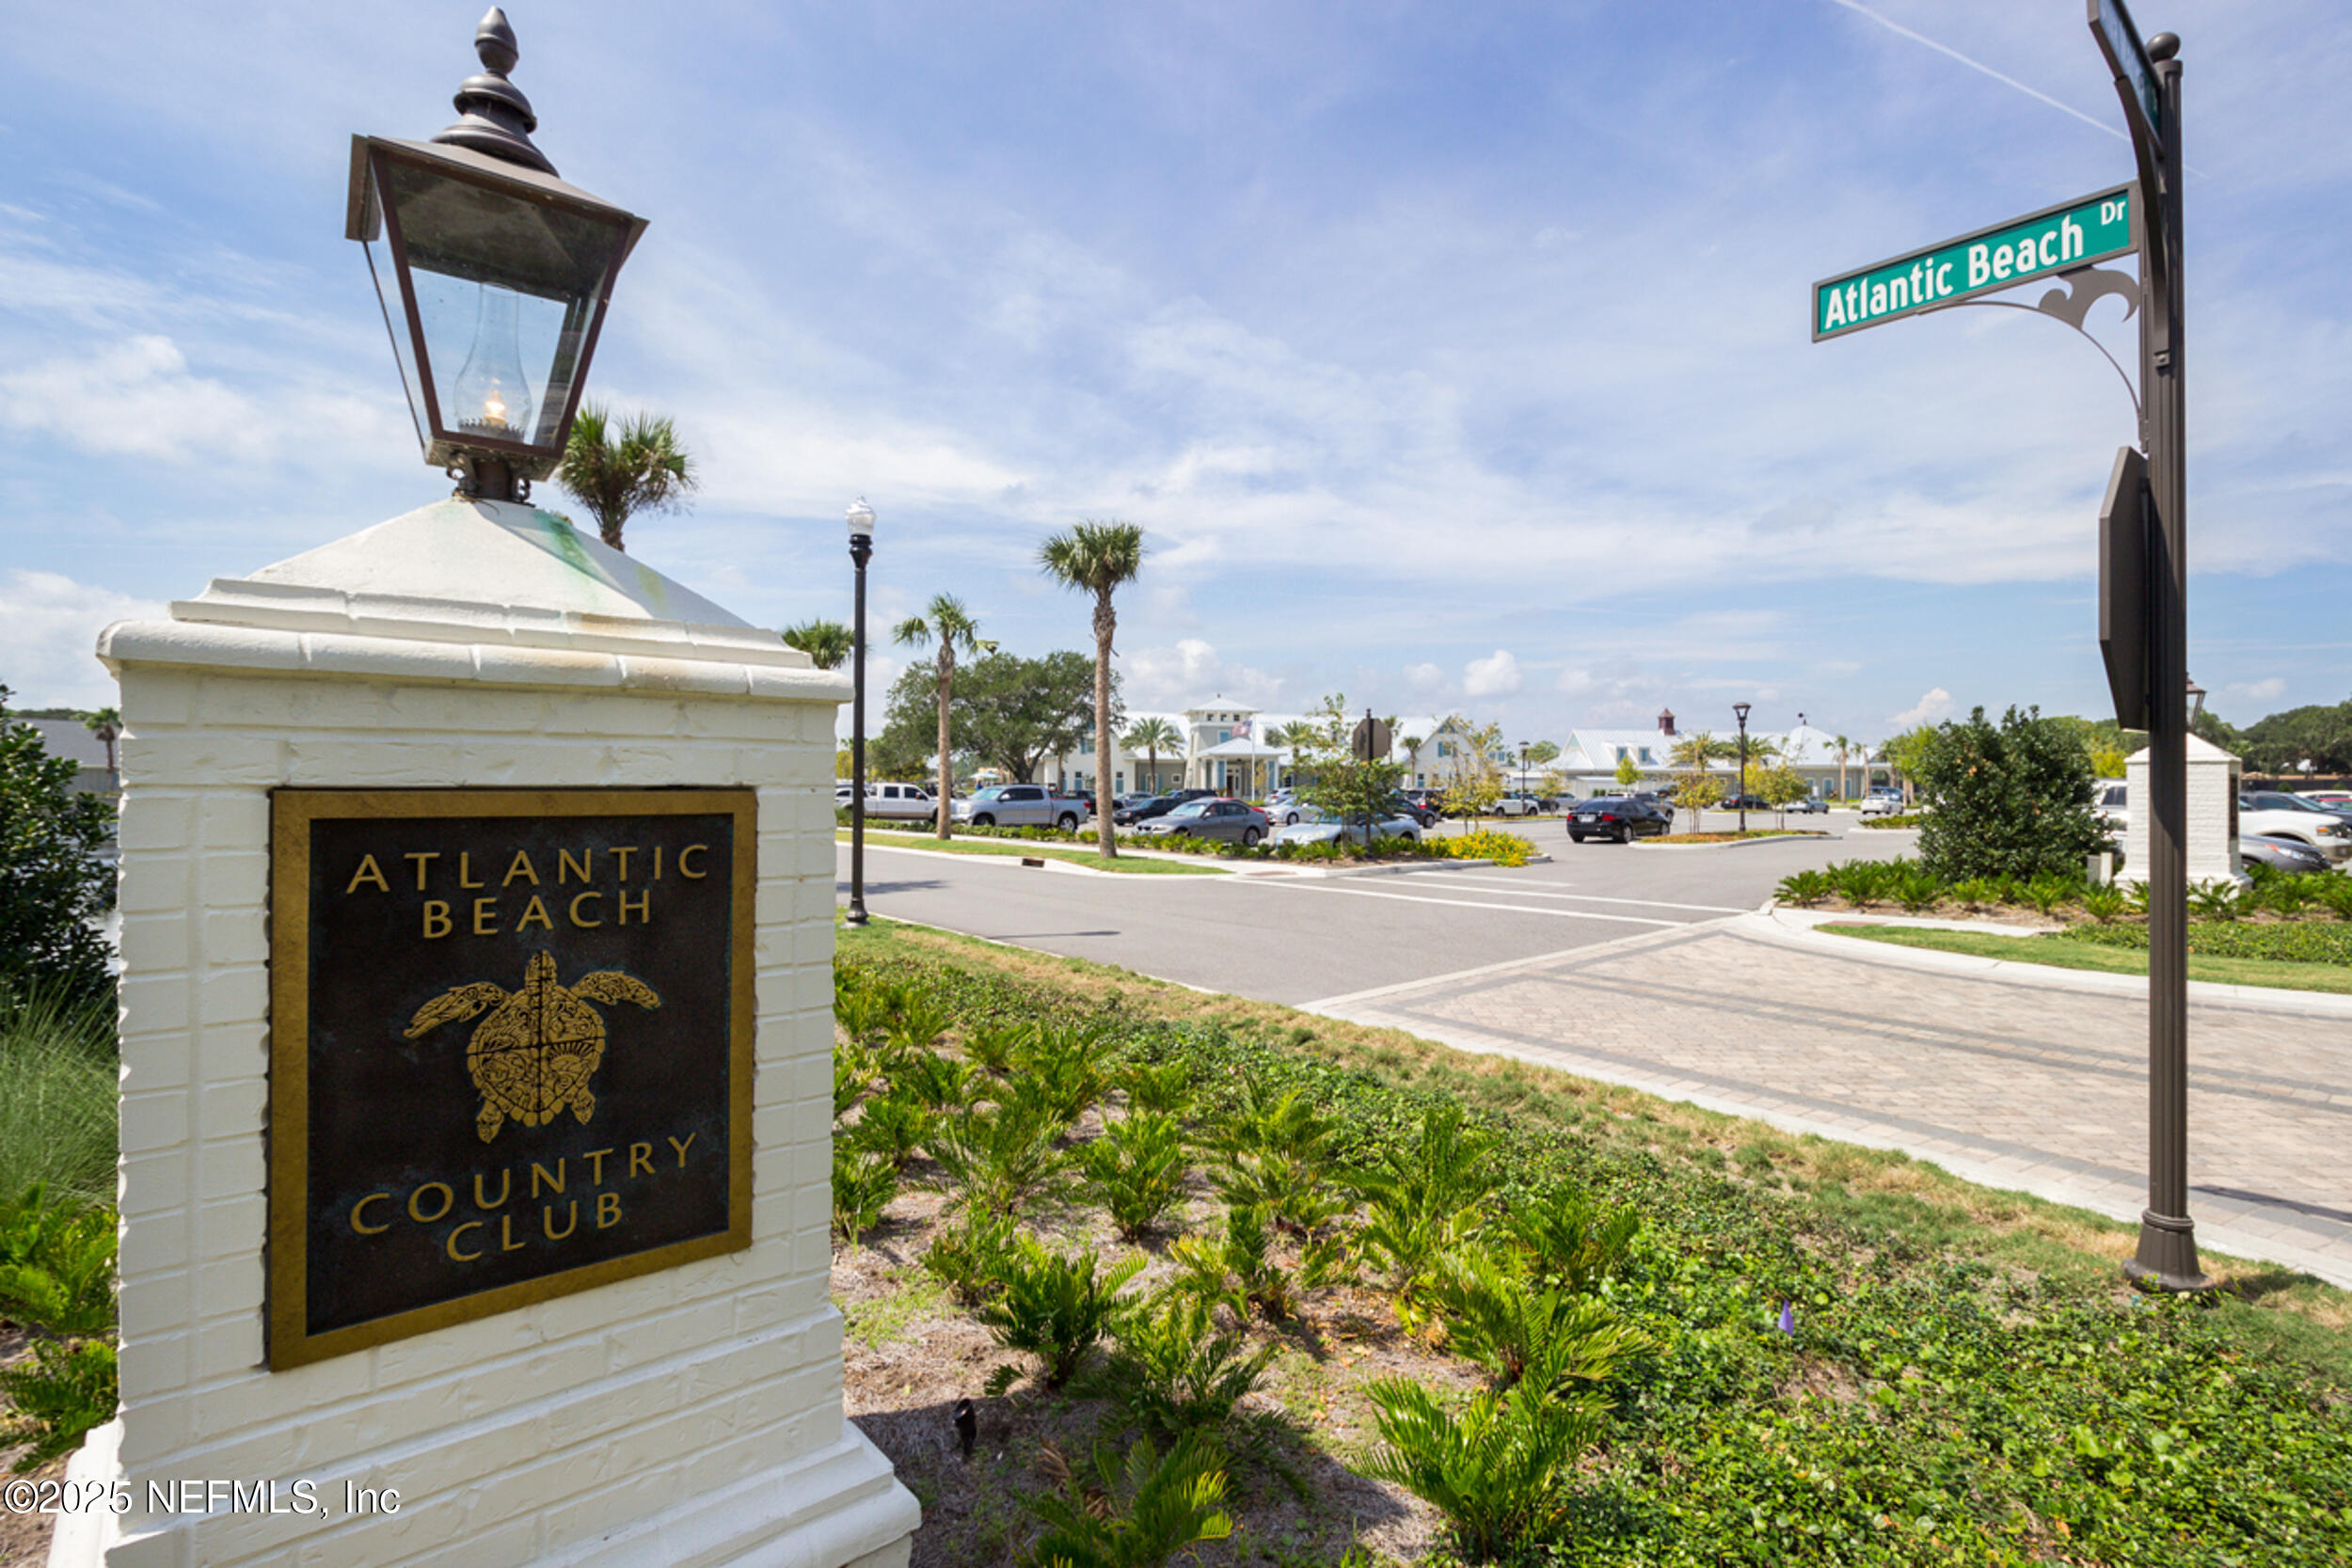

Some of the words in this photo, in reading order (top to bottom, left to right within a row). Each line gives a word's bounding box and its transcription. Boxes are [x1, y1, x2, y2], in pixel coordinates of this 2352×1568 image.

[1824, 258, 1953, 329] Atlantic
[1967, 215, 2084, 288] Beach
[2100, 199, 2126, 226] Dr
[345, 845, 708, 895] ATLANTIC
[422, 889, 651, 939] BEACH
[350, 1132, 696, 1235] COUNTRY
[446, 1192, 624, 1262] CLUB
